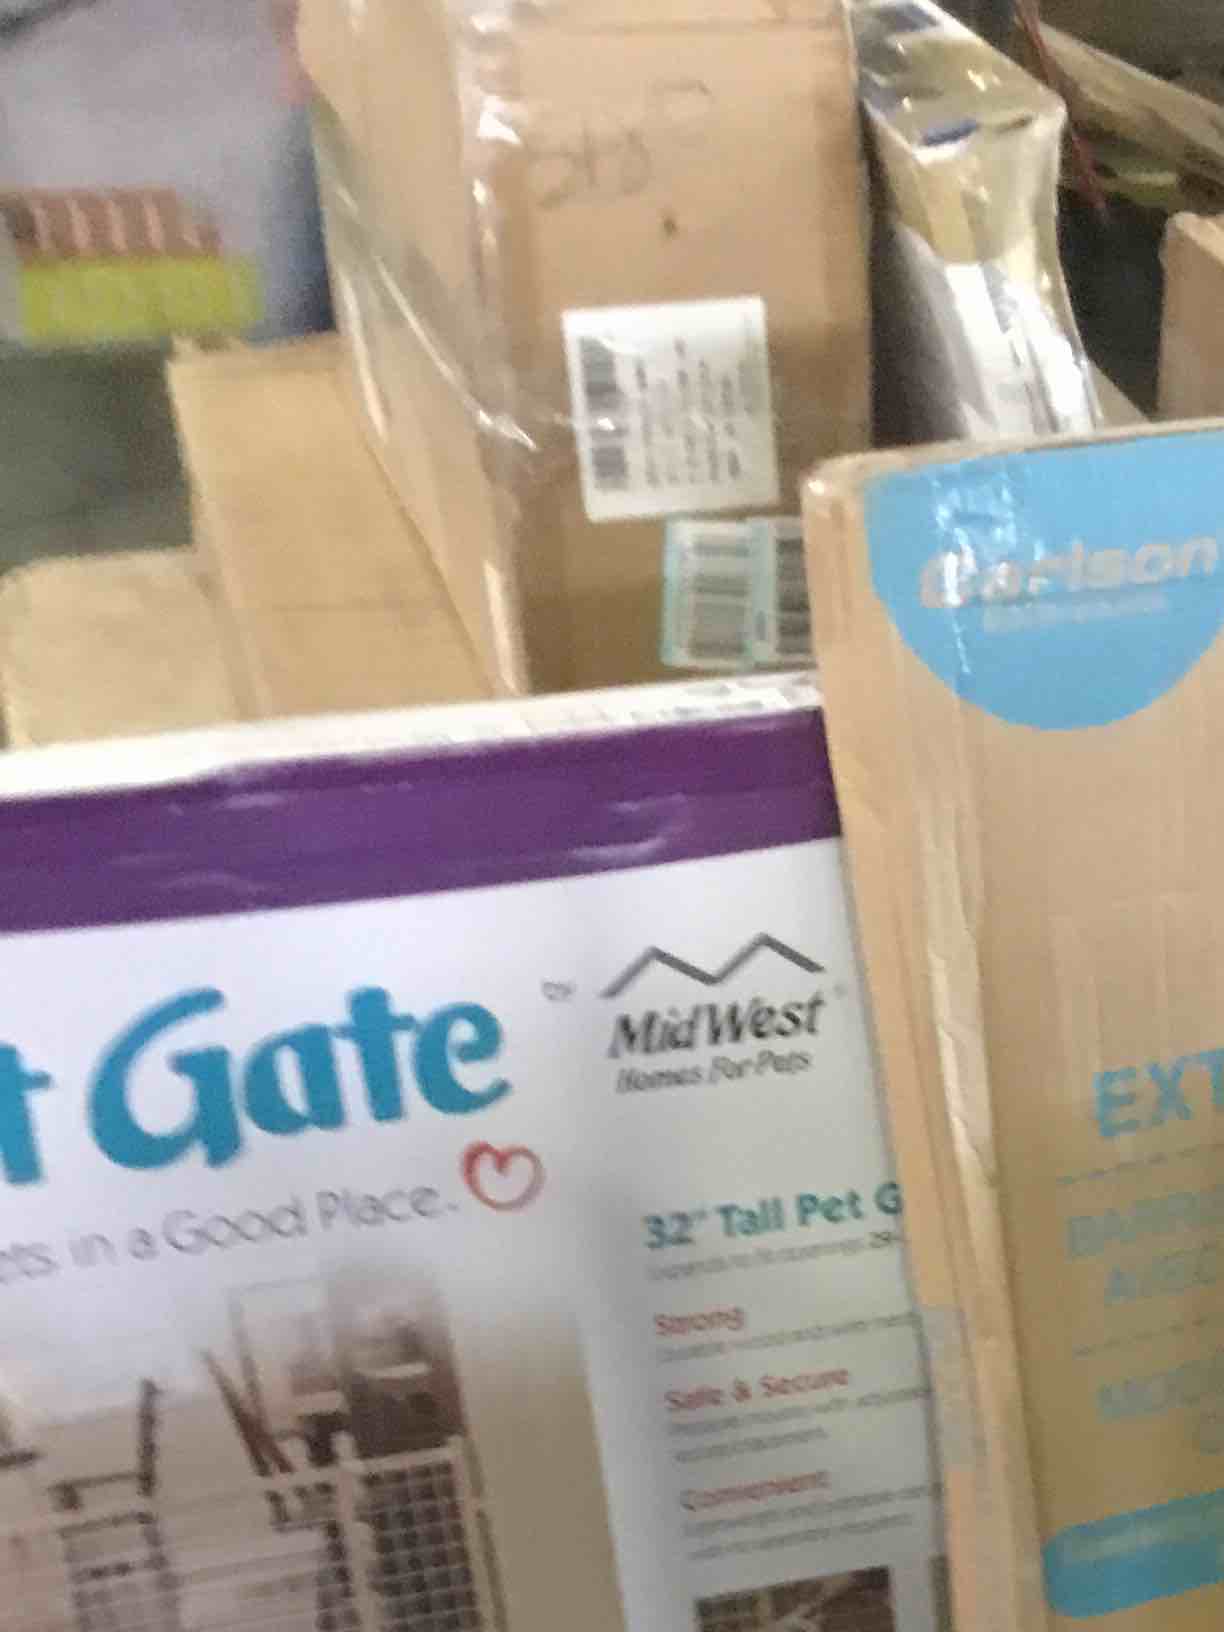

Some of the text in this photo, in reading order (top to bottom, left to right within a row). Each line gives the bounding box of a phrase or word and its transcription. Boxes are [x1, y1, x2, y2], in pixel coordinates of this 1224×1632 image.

[606, 990, 826, 1060] MidWest
[88, 986, 514, 1171] Gate
[68, 1226, 117, 1268] in
[160, 1193, 309, 1254] Good
[313, 1184, 461, 1230] Place.
[715, 1196, 785, 1238] Tall
[795, 1187, 864, 1228] Pet
